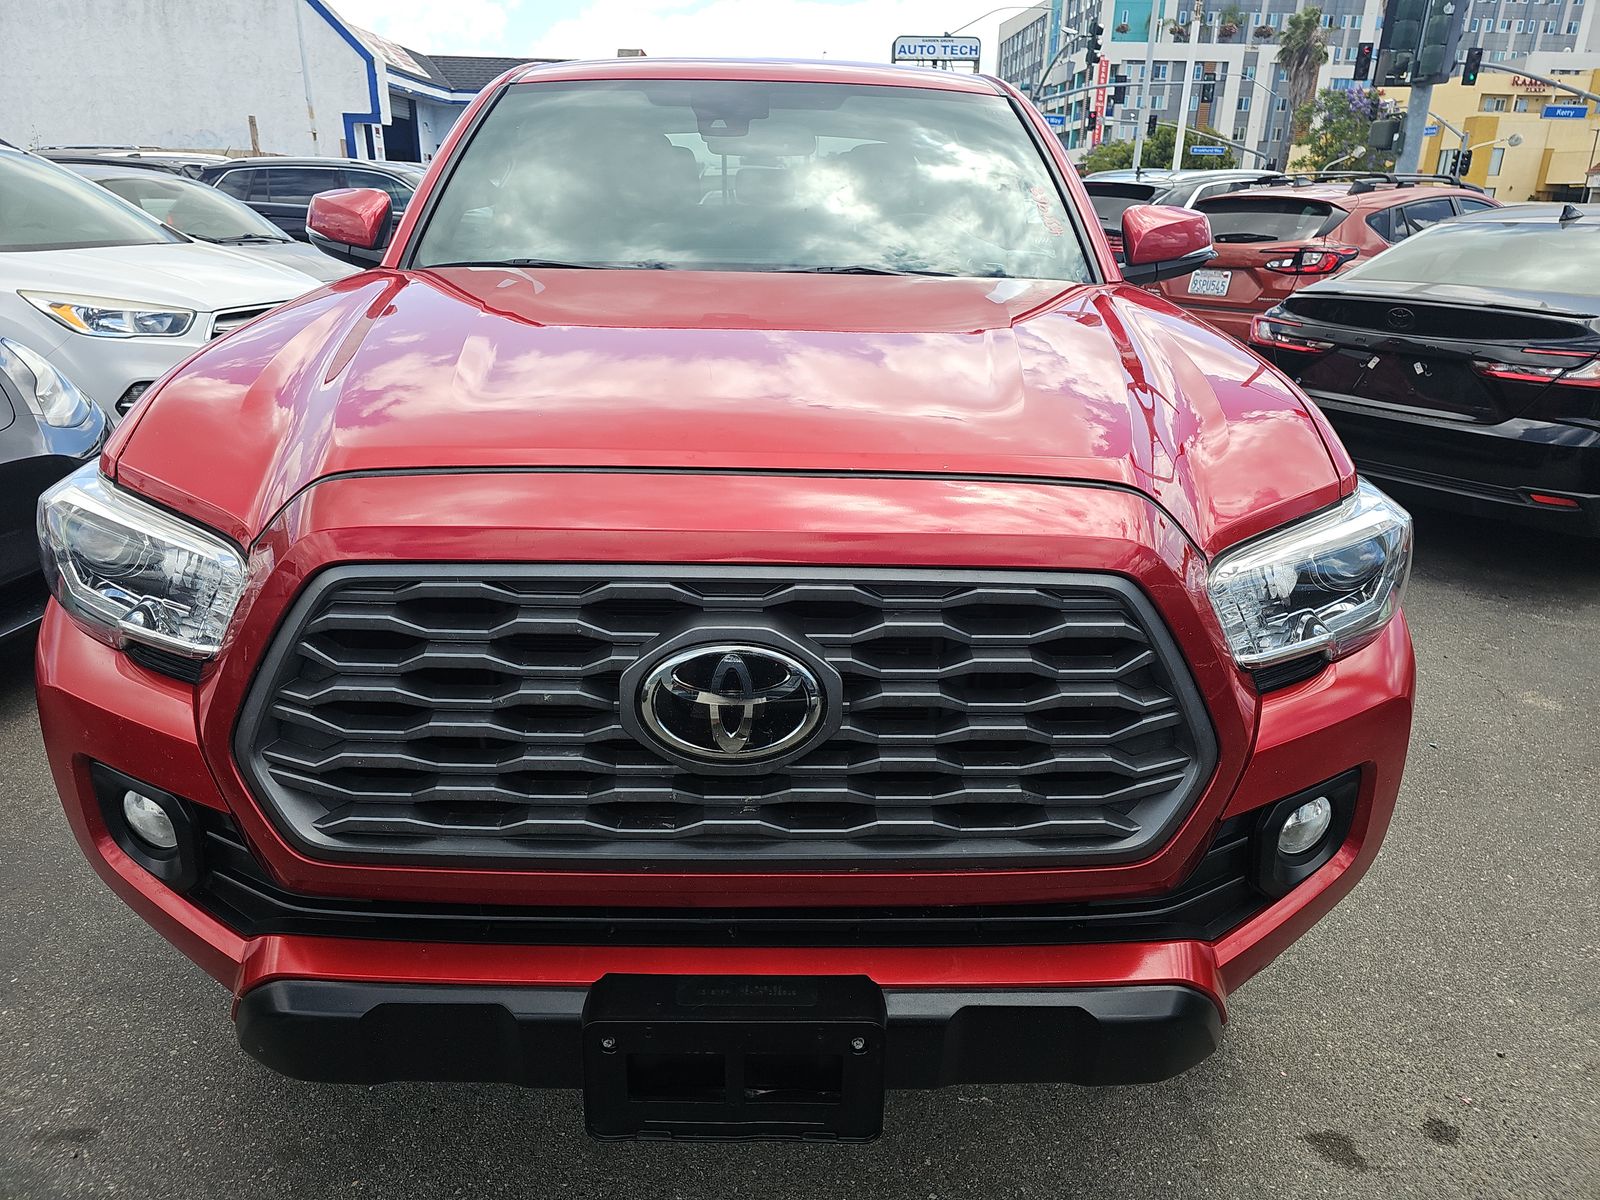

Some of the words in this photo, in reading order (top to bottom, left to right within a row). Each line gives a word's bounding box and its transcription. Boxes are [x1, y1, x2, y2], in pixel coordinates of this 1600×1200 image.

[898, 44, 936, 55] AUTO
[942, 45, 978, 55] TECH
[1098, 61, 1107, 100] LEASNG
[1556, 109, 1575, 117] Kerry
[1191, 279, 1227, 291] 9SPU545
